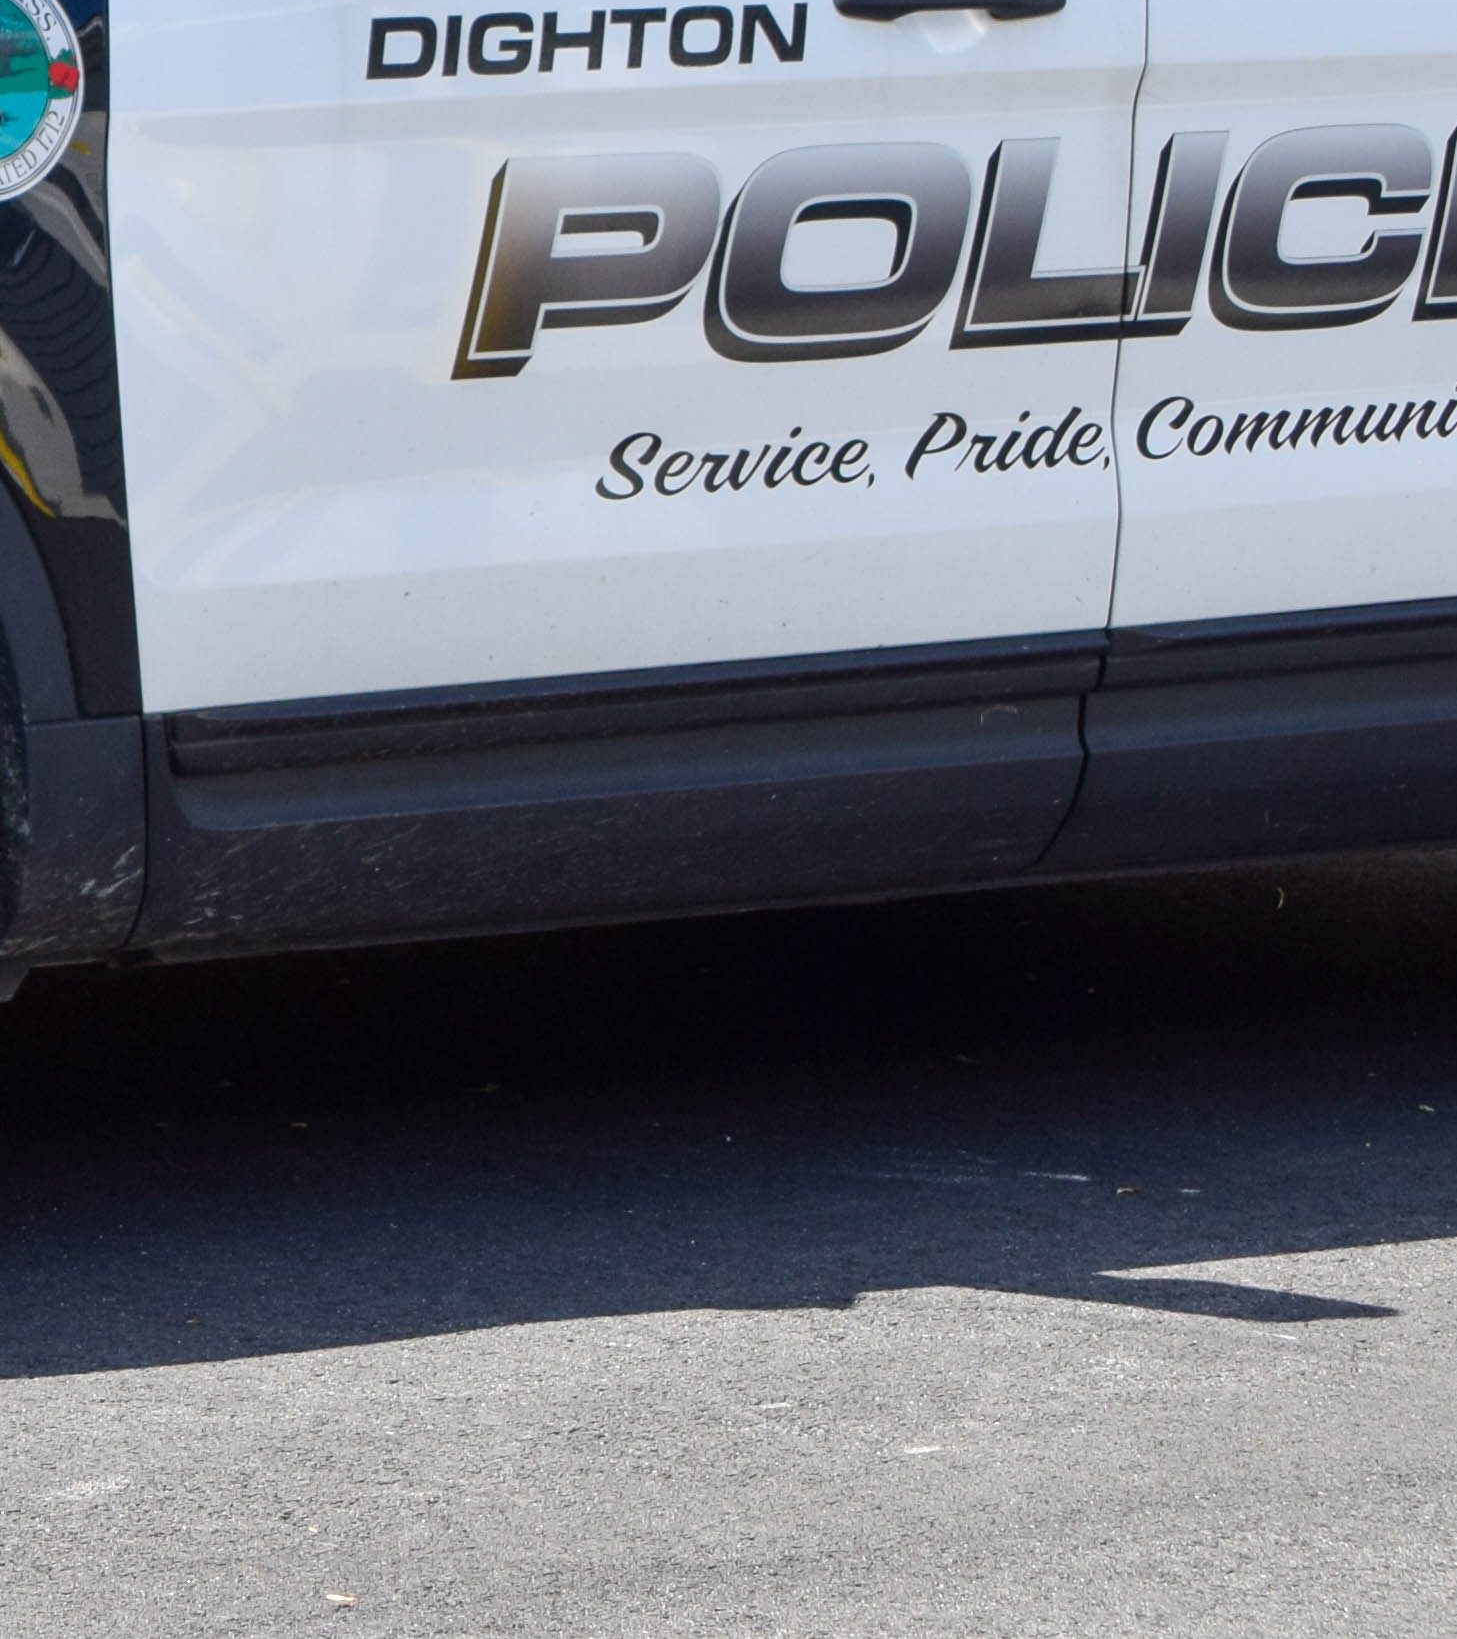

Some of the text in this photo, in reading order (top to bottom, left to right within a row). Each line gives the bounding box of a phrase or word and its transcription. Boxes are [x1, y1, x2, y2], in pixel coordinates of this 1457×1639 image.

[366, 2, 809, 81] DIGHTON
[595, 426, 876, 501] Service,
[904, 405, 1111, 481] Pride,
